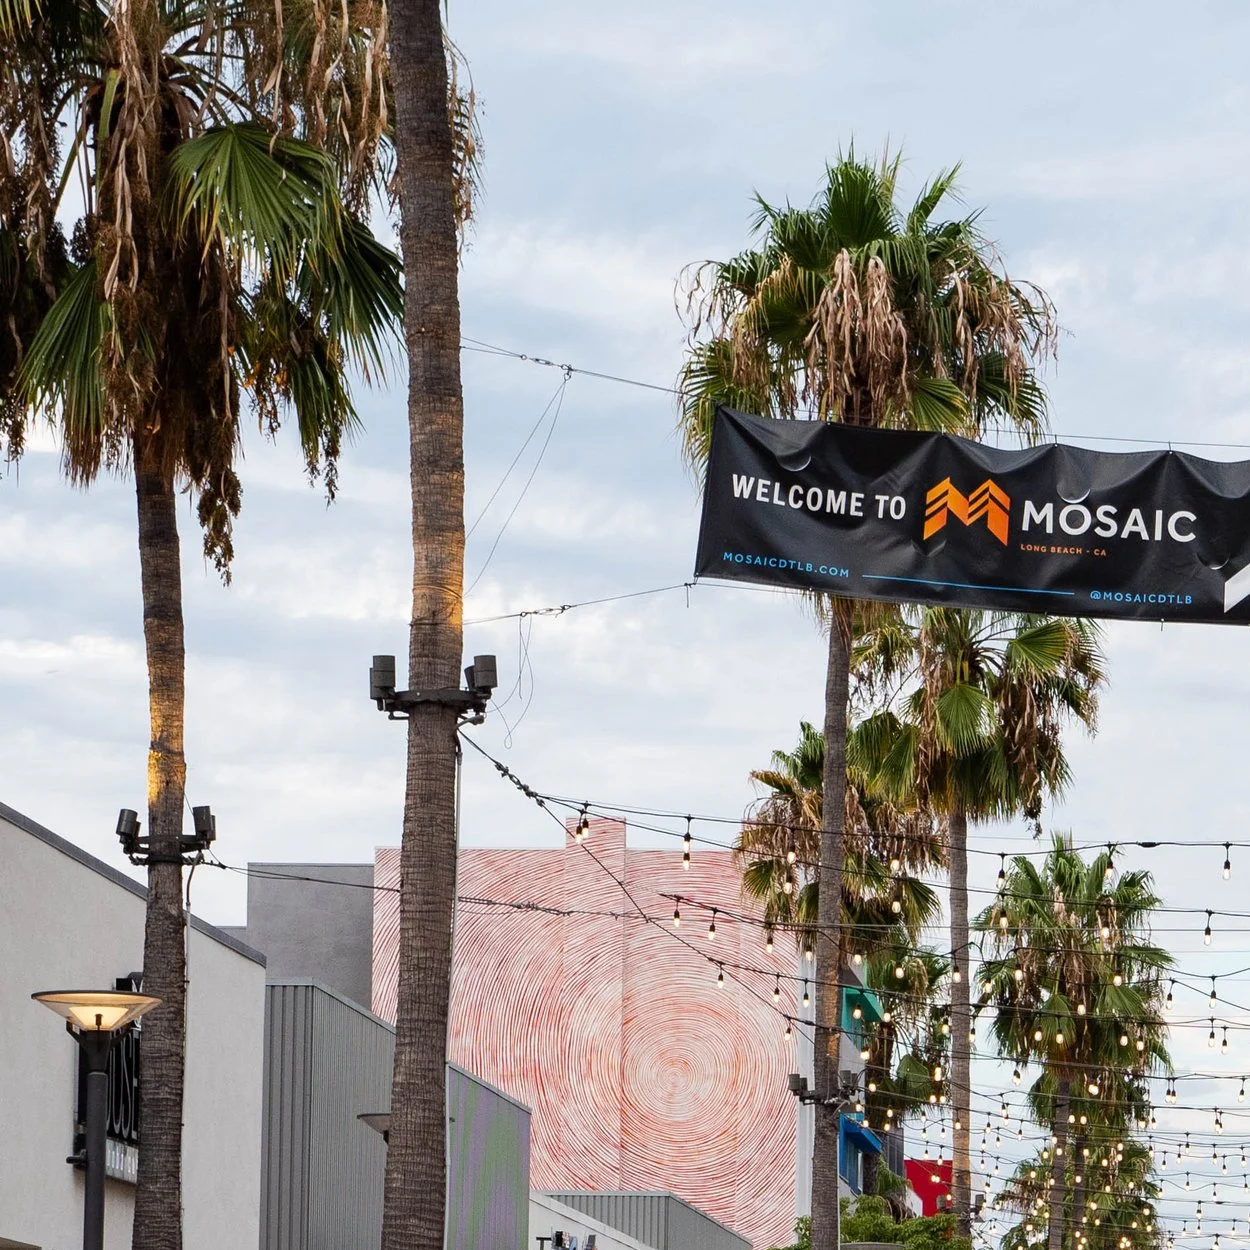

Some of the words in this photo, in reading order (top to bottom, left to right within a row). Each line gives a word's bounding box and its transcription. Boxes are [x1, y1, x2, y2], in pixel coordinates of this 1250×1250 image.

[732, 474, 865, 517] WELCOME
[875, 495, 907, 520] TO
[1022, 500, 1197, 543] MOSAIC
[1020, 543, 1047, 553] LONG
[1050, 546, 1083, 555] BEACH
[723, 551, 850, 578] MOSAICDTLB.COM
[1090, 590, 1193, 605] @MOSAICDTLB
